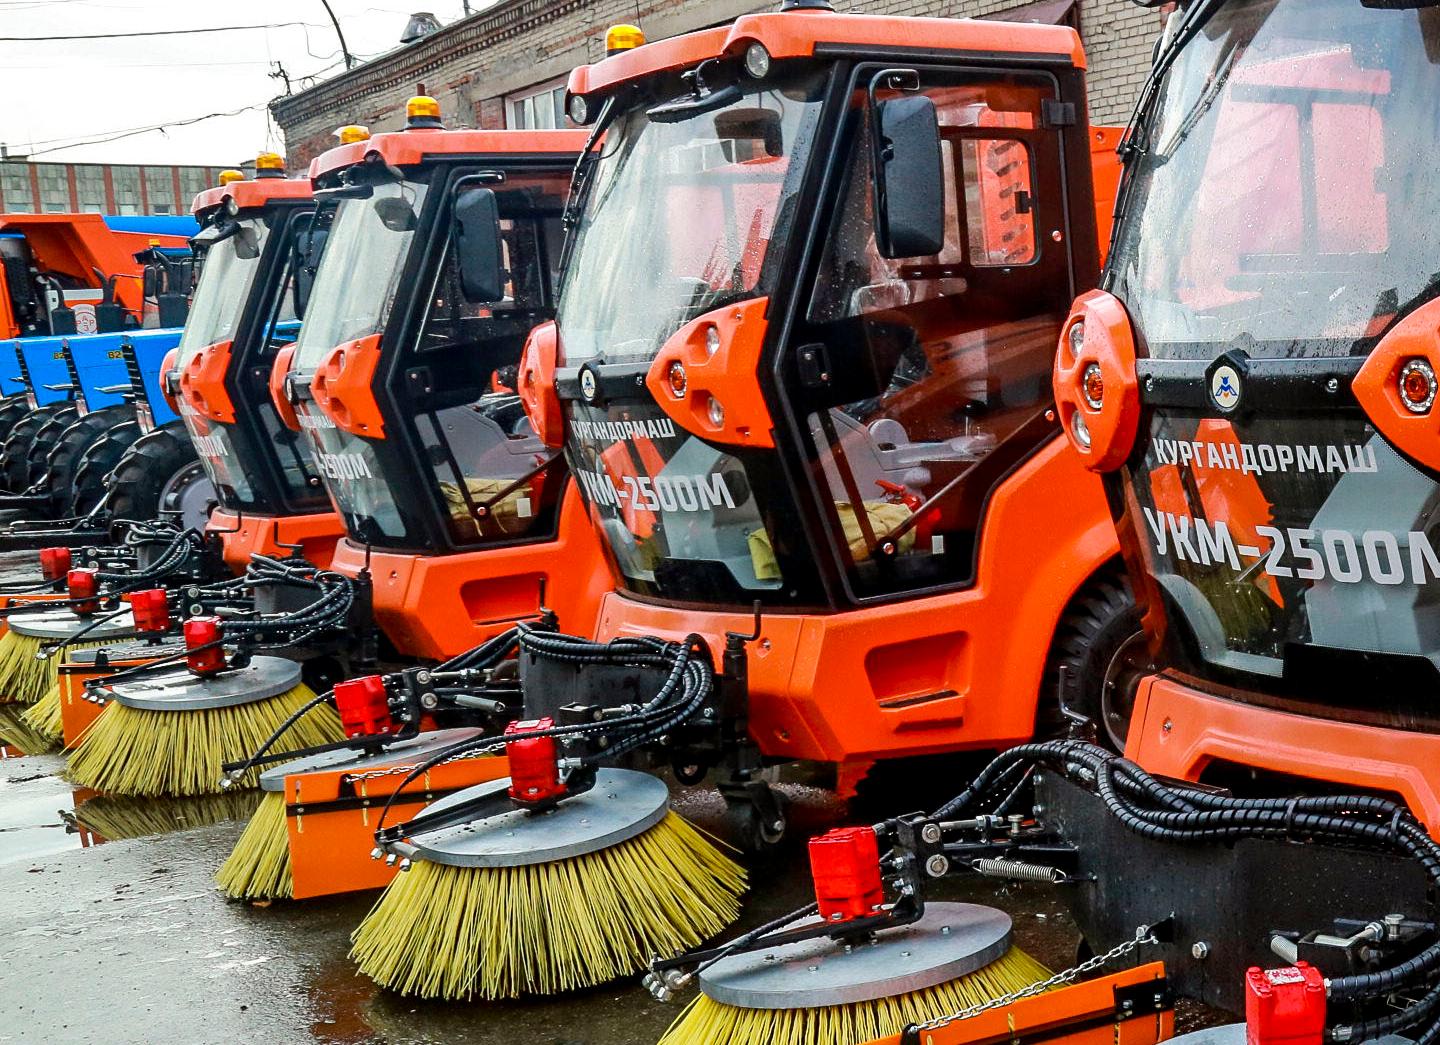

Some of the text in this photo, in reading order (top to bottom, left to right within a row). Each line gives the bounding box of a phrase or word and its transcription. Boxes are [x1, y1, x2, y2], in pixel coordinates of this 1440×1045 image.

[570, 418, 676, 441] КУРГАНДОРМАШ
[1152, 438, 1378, 475] КУРГАНДОРМАШ
[577, 468, 736, 512] УКМ-2500М
